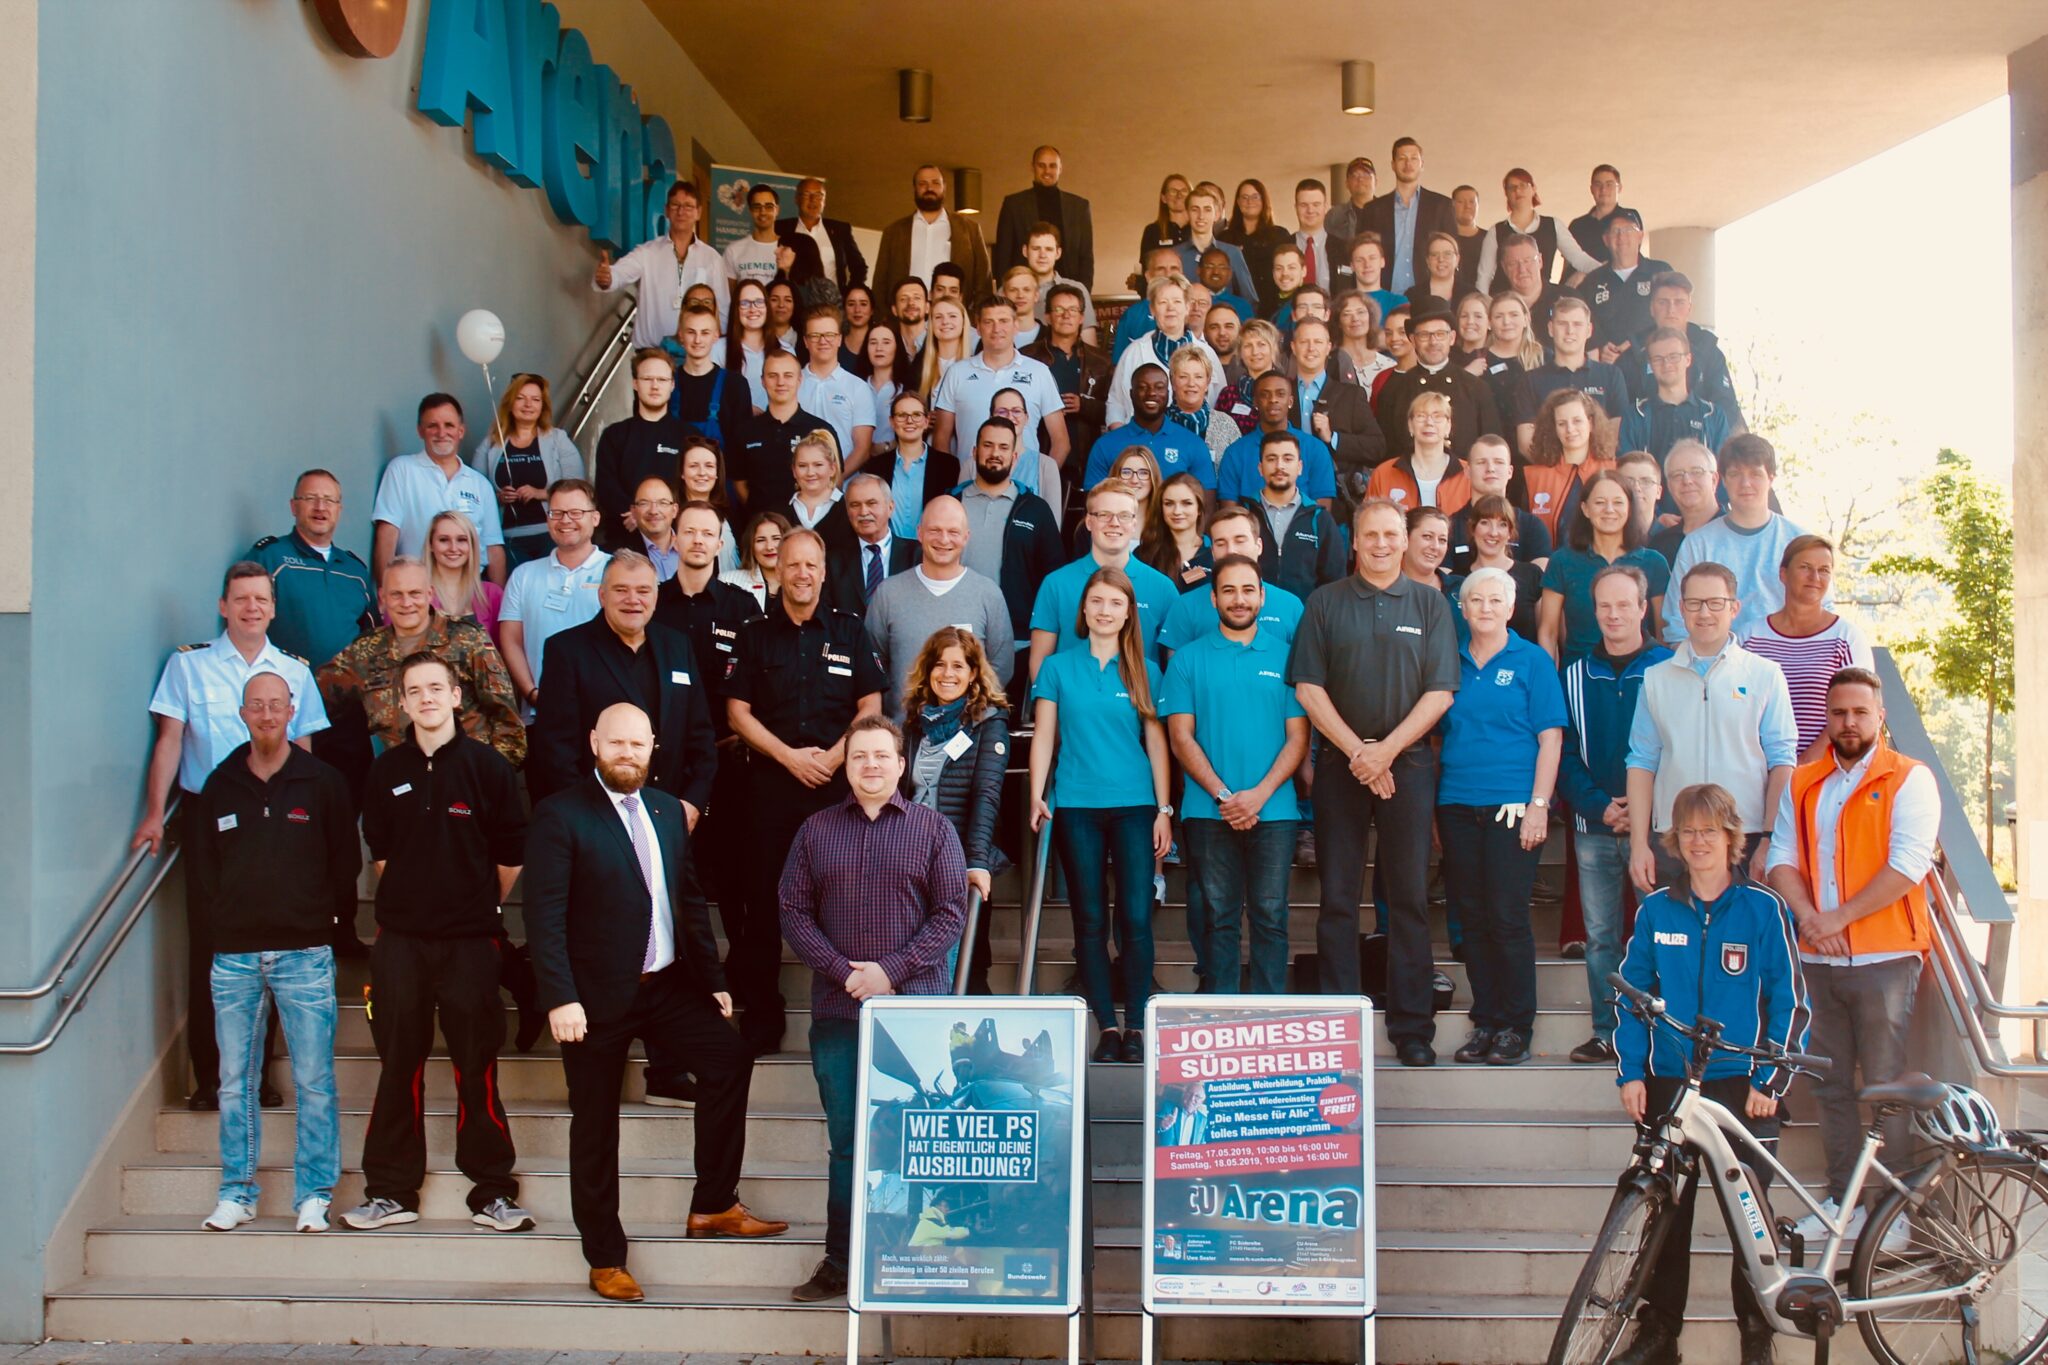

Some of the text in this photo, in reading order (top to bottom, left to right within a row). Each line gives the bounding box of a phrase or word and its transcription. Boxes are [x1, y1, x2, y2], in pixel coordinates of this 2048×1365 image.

[417, 0, 676, 257] Arena
[738, 262, 775, 270] SIEMEN
[714, 628, 736, 639] POLIZE
[1396, 626, 1422, 636] AIRBUS
[828, 654, 850, 664] POLIZEI
[1258, 670, 1281, 678] AIRBUS
[1654, 932, 1688, 946] POLIZEI
[1172, 1019, 1346, 1052] JOBMESSE
[1180, 1050, 1343, 1078] SÜDERELBE
[1208, 1076, 1337, 1092] Ausbildung, Weiterbildung, Praktika
[1210, 1094, 1315, 1108] Jobwechsel, Wiedereinstieg
[1320, 1095, 1356, 1106] EINTRITT
[1324, 1103, 1356, 1116] FREI!
[1210, 1114, 1232, 1124] „Die
[1234, 1112, 1269, 1122] Messe
[1271, 1110, 1286, 1120] für
[909, 1115, 1033, 1139] WIE VIEL PS
[1210, 1123, 1330, 1139] tolles Rahmenprogramm
[908, 1140, 1032, 1154] HAT EIGENTLICH DEINE
[1170, 1152, 1204, 1160] Freitag,
[1256, 1146, 1280, 1154] 10:00
[1282, 1144, 1295, 1152] bis
[1298, 1142, 1322, 1151] 16:00
[1324, 1142, 1340, 1150] Uhr
[907, 1156, 1032, 1177] AUSBILDUNG?
[1170, 1151, 1348, 1170] Samstag, 18.05.2019, 10:00 bis 16:00 Uhr
[1190, 1184, 1360, 1230] CU Arena
[1742, 1196, 1763, 1234] POLIZEI
[912, 1254, 932, 1262] wirklich
[881, 1265, 915, 1274] Ausbildung
[924, 1265, 938, 1274] über
[940, 1266, 948, 1274] 50
[948, 1266, 968, 1274] zivilen
[970, 1266, 994, 1274] Berufen
